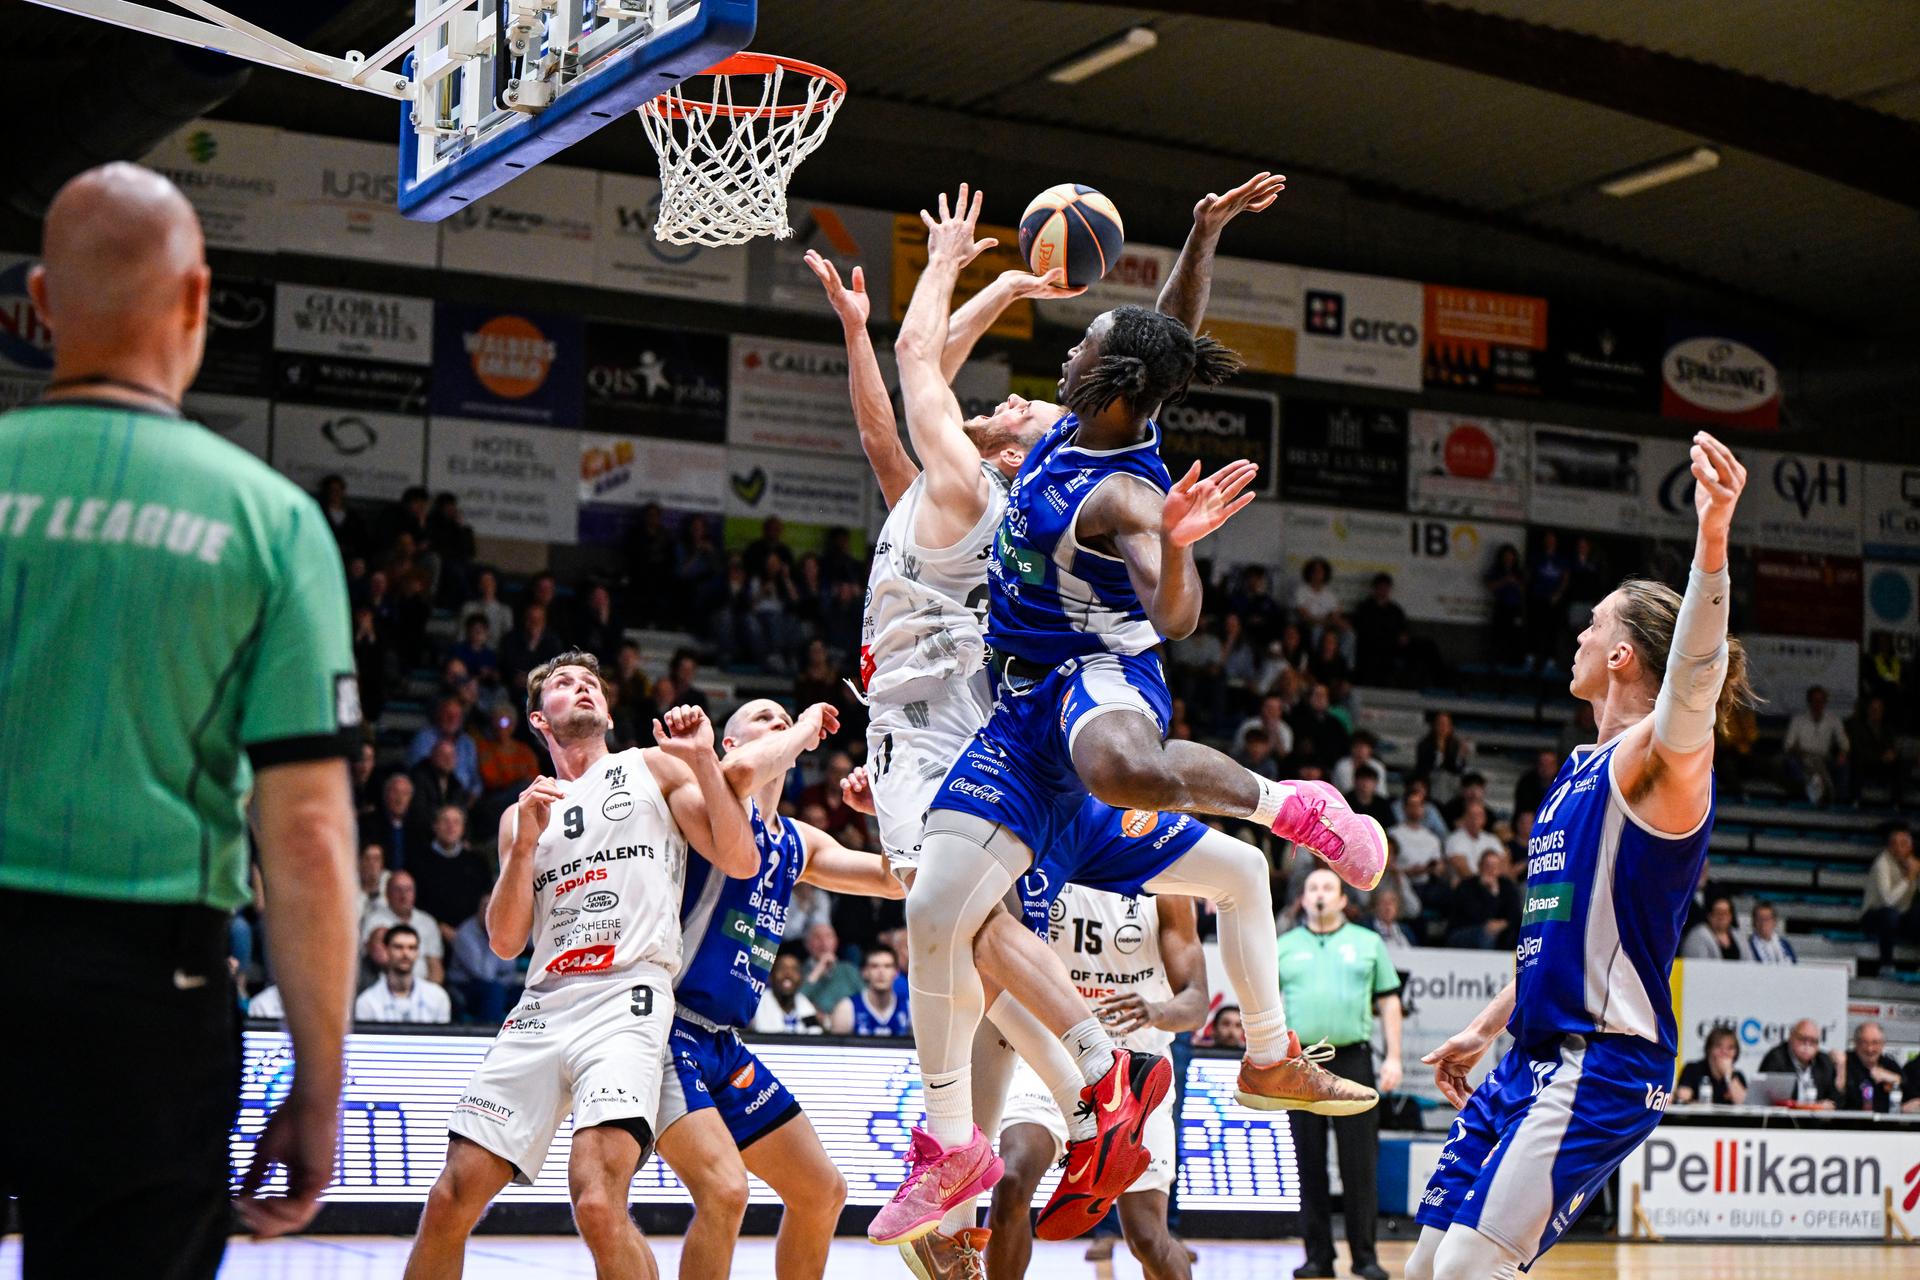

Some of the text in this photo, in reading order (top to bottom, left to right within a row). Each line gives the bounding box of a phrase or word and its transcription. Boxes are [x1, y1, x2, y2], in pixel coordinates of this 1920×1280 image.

[1351, 318, 1418, 347] arco
[768, 352, 848, 376] CALLAN
[1675, 356, 1765, 393] SPALDING
[1162, 406, 1247, 437] COACH
[1047, 485, 1069, 511] CALLANT
[46, 497, 232, 565] LEAGUE
[971, 760, 1000, 776] Centre
[605, 800, 632, 812] cobras
[563, 805, 584, 840] 9
[533, 844, 654, 892] USE OF TALENTS
[764, 850, 781, 889] 2
[551, 917, 578, 931] JAGUA
[1072, 918, 1103, 955] 15
[1071, 968, 1154, 985] OF TALENTS
[1411, 972, 1509, 1002] palmki
[630, 984, 654, 1017] 9
[467, 1095, 514, 1118] MOBILITY
[745, 1081, 780, 1115] sodiwe
[1645, 1083, 1672, 1112] Van
[1642, 1139, 1881, 1196] Pellikaan
[1730, 1210, 1783, 1228] BUILD
[1803, 1210, 1882, 1229] OPERATE
